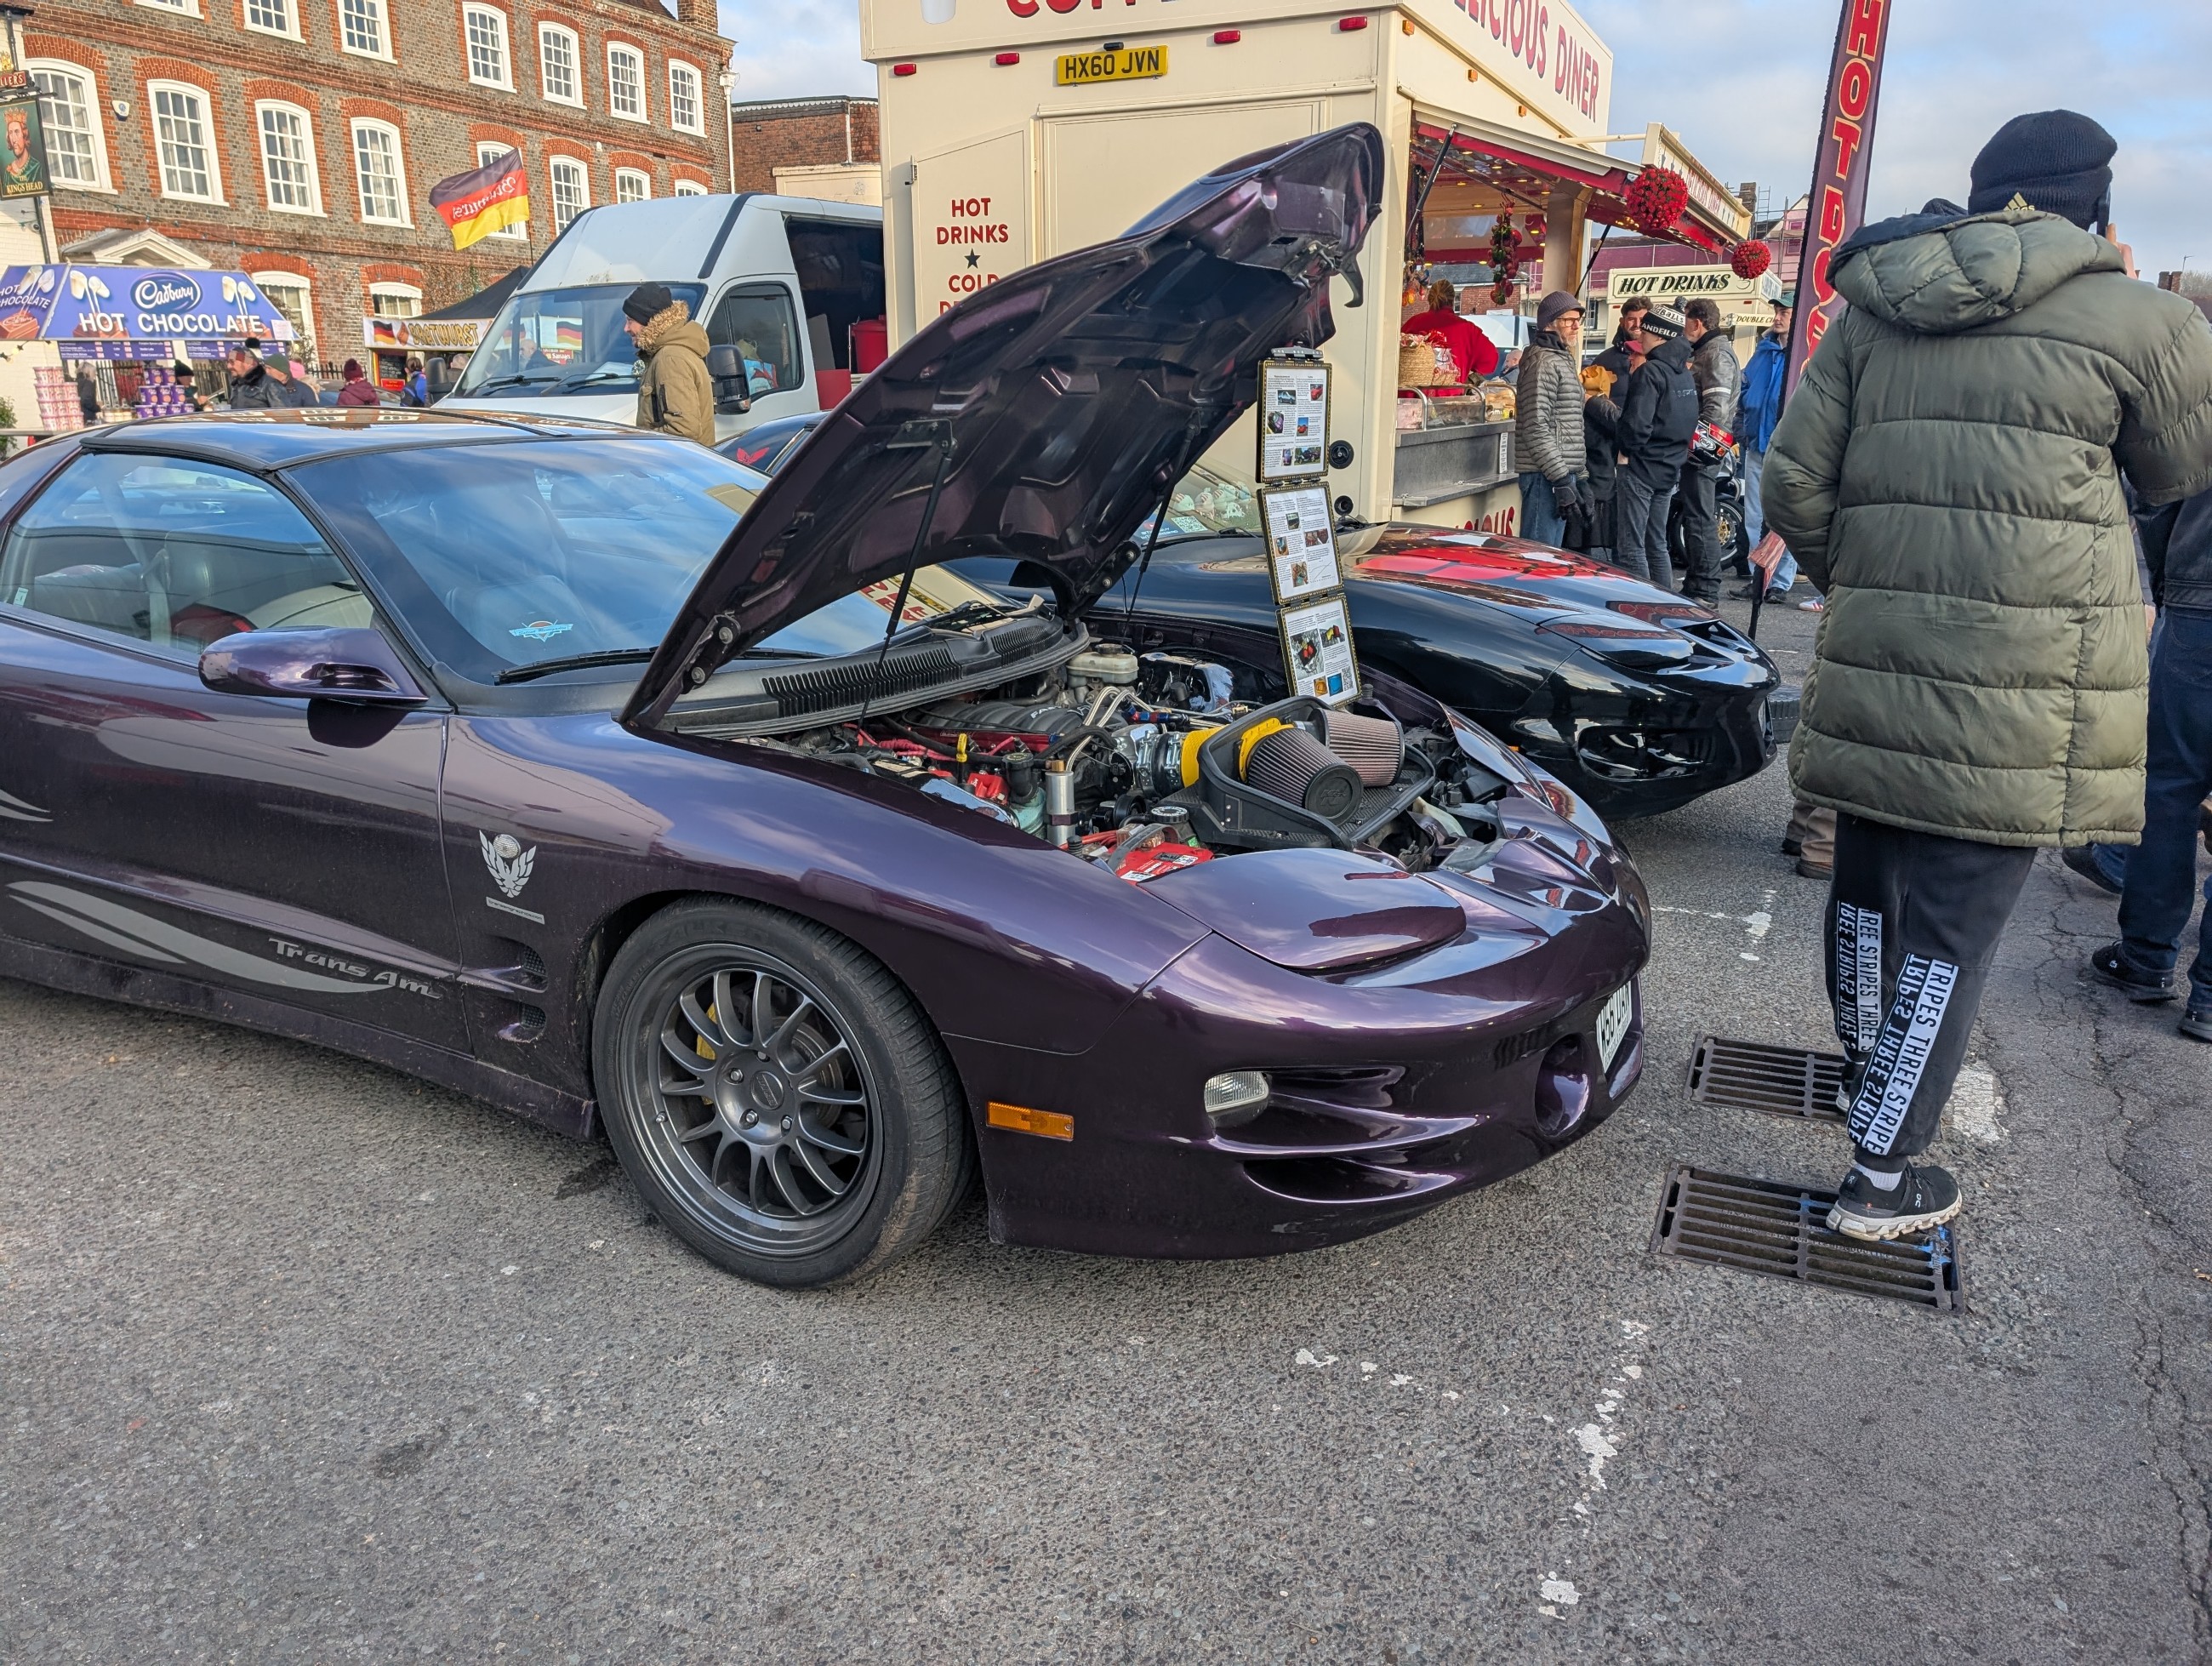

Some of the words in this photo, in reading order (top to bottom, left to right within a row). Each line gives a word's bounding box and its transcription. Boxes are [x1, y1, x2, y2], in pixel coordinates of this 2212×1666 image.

[1065, 53, 1115, 79] HX60
[1121, 49, 1160, 75] JVN
[1555, 24, 1599, 123] DINER
[1832, 0, 1885, 182] HOT
[7, 184, 26, 194] KINGS
[26, 181, 43, 191] HEAD
[951, 197, 991, 217] HOT
[937, 224, 1009, 245] DRINKS
[1617, 276, 1659, 295] HOT
[1658, 273, 1731, 294] DRINKS
[1799, 183, 1846, 374] DOG
[0, 295, 51, 309] HOCOLATE
[135, 280, 194, 310] Cadbury
[79, 312, 125, 333] HOT
[137, 313, 264, 334] CHOCOLATE
[408, 322, 478, 346] BRATWURST
[268, 937, 372, 978] Trans
[373, 971, 443, 1000] Am
[1860, 944, 1878, 996] STRIPES
[1861, 1003, 1878, 1040] THREE
[1892, 1035, 1930, 1090] THREE
